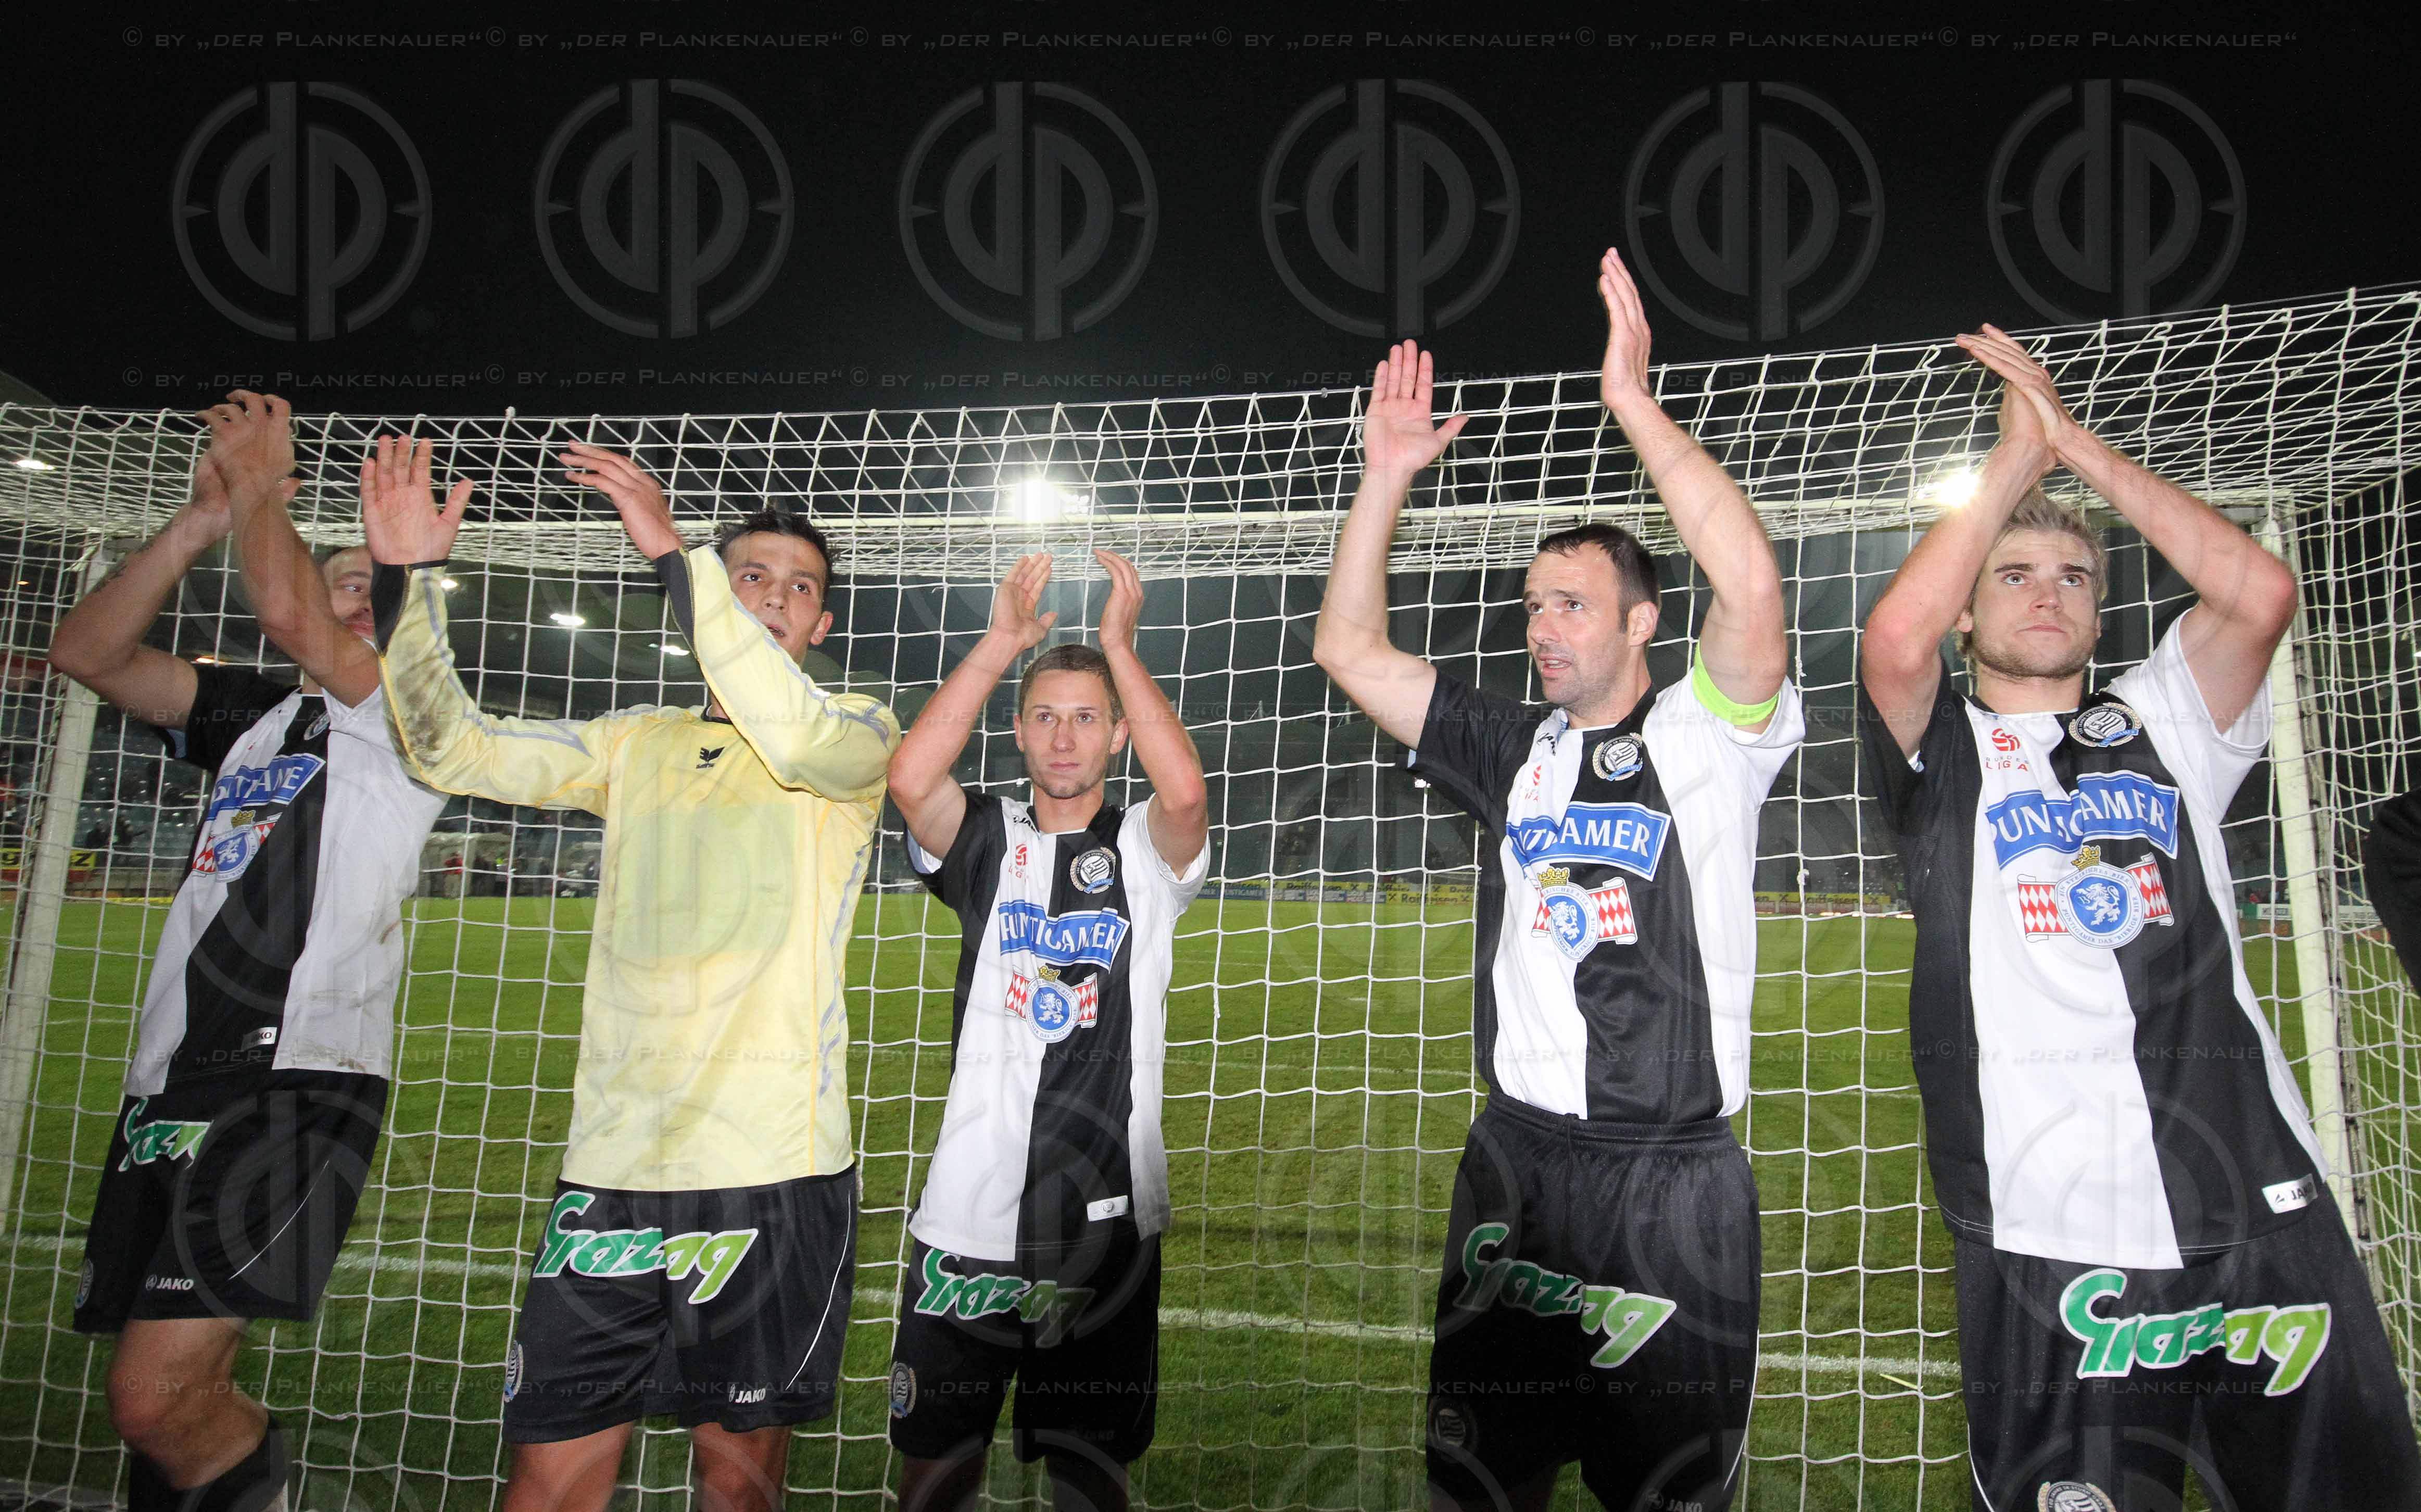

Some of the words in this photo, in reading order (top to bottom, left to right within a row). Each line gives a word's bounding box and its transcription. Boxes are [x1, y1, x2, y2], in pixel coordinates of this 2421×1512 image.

[1987, 760, 2028, 771] LIGA
[156, 1277, 194, 1290] JAKO
[735, 1388, 766, 1404] JAKO
